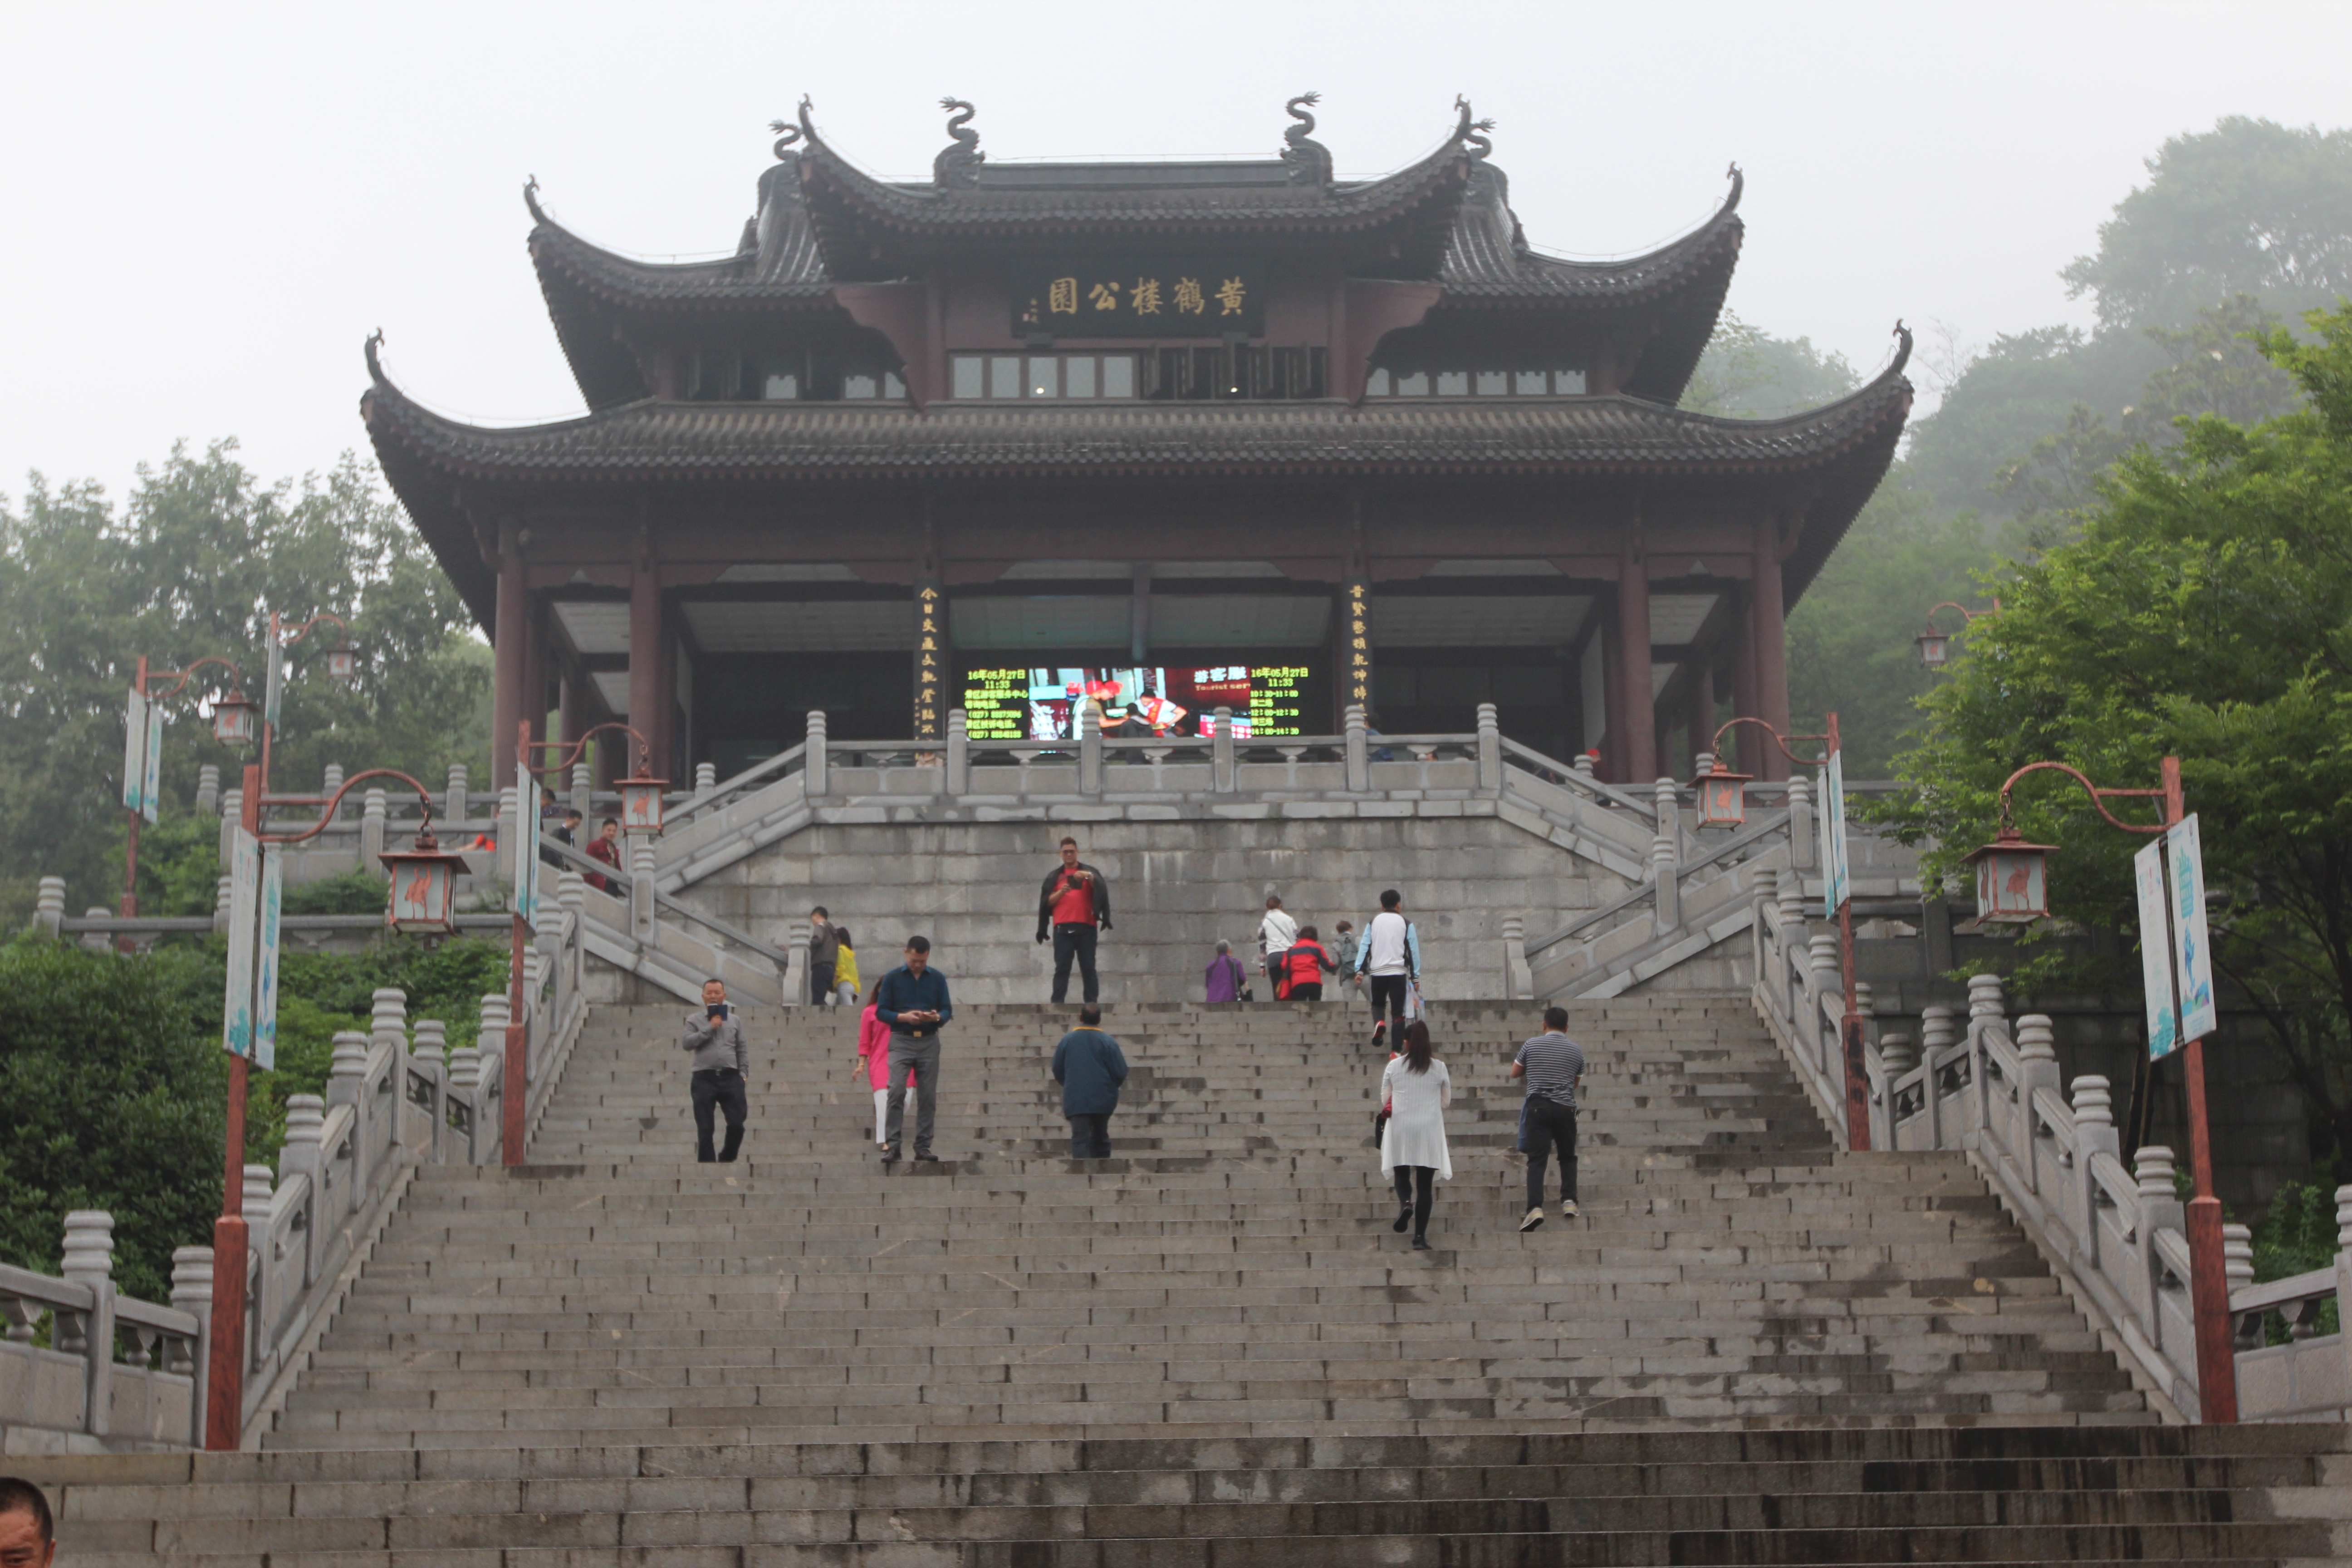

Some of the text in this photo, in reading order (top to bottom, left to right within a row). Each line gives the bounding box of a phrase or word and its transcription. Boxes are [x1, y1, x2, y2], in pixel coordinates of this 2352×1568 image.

[968, 668, 1026, 681] 16年05月27日
[1194, 666, 1247, 683] 游客服
[1251, 666, 1308, 678] 16年05月27日
[985, 680, 1011, 689] 11:33
[1268, 678, 1294, 687] 11:33
